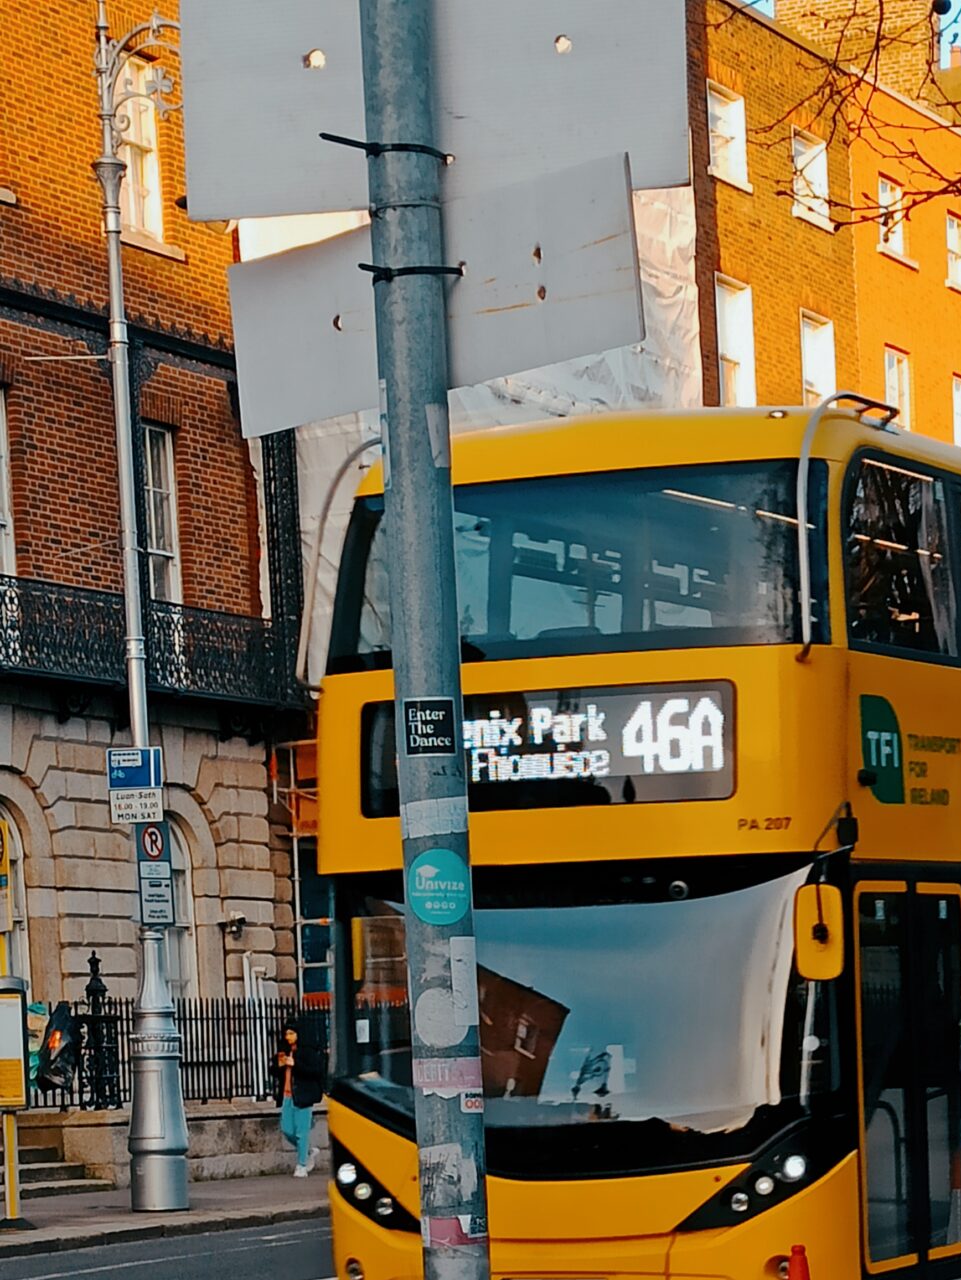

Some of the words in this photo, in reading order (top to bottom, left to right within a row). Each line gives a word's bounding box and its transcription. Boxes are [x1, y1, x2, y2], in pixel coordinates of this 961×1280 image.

[408, 708, 446, 721] Enter
[408, 720, 435, 735] The
[530, 703, 608, 745] Park
[622, 697, 725, 773] 46A
[409, 734, 453, 748] Dance
[866, 730, 900, 768] TFI
[907, 733, 961, 754] TRANSPORT
[908, 760, 929, 778] FOR
[910, 787, 950, 806] IRELAND
[737, 818, 760, 831] PA
[415, 875, 466, 891] Univize
